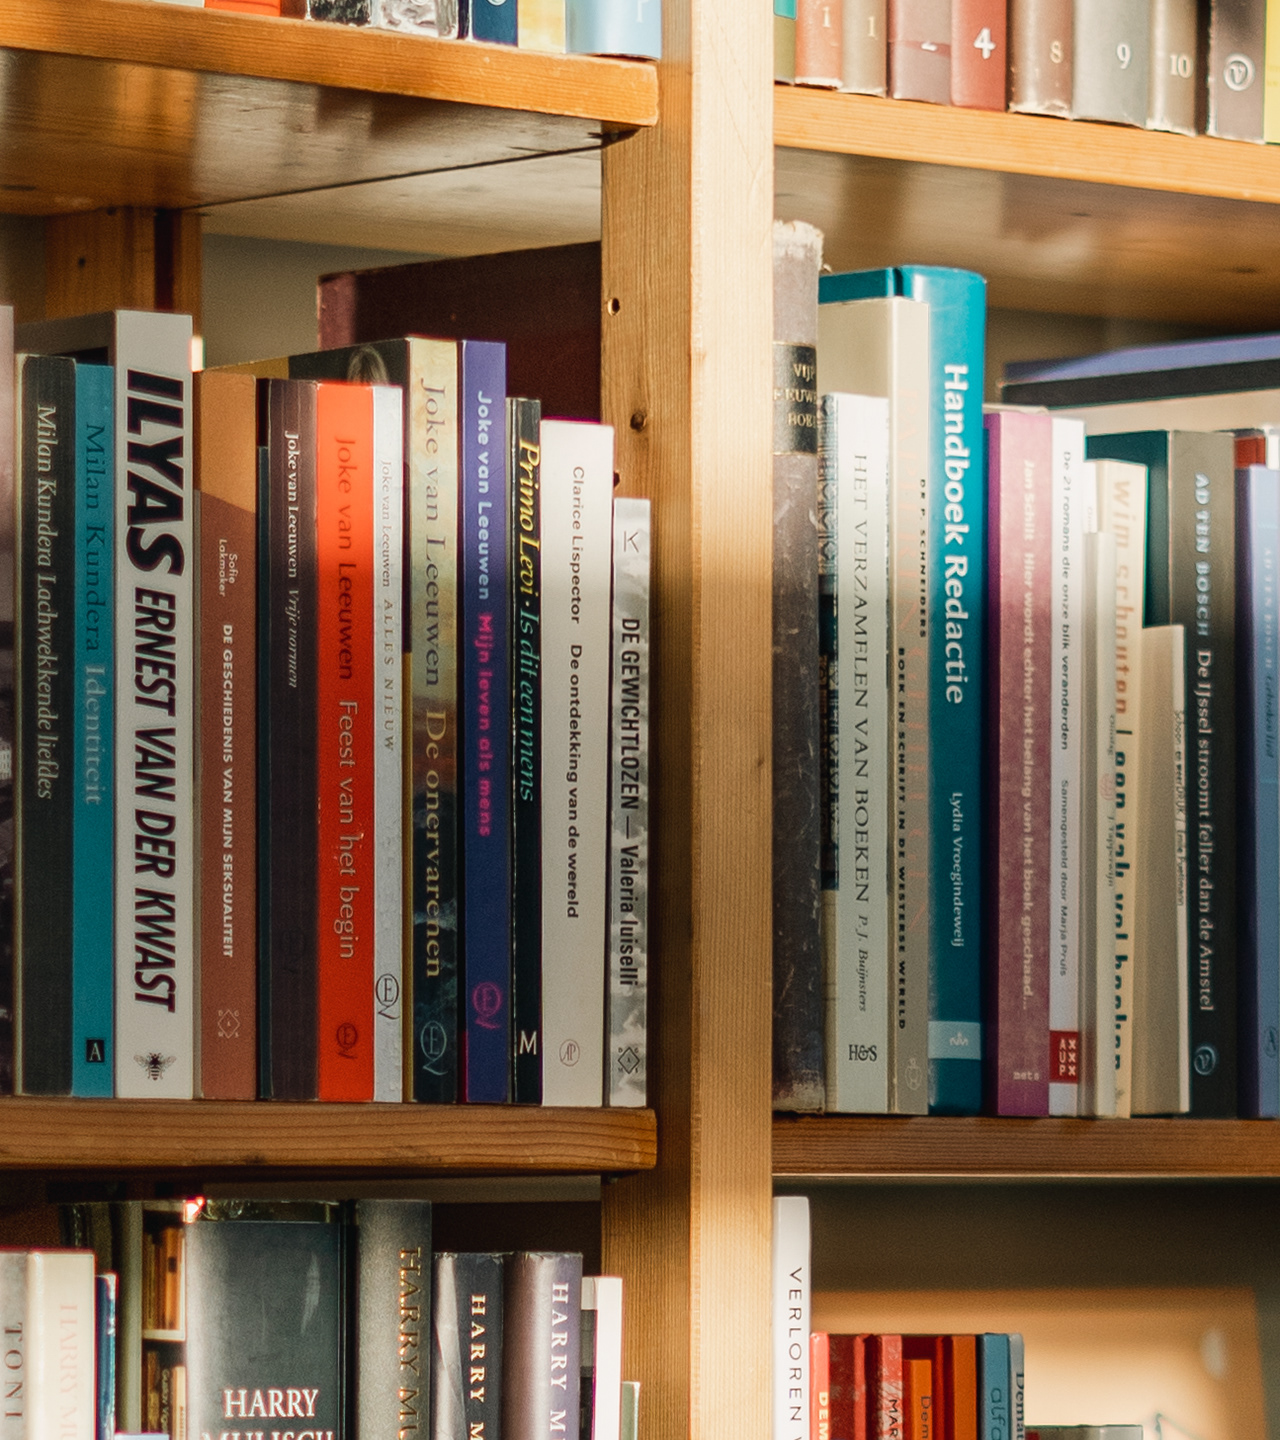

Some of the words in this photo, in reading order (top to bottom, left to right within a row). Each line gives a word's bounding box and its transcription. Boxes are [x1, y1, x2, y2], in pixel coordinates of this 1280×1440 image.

[973, 27, 996, 60] 4
[1117, 41, 1132, 69] 9
[125, 368, 185, 579] ILYAS
[943, 363, 969, 546] Handboek
[572, 466, 585, 530] Clarice
[571, 536, 584, 626] Lispector
[134, 585, 177, 718] ERNEST
[569, 643, 583, 670] De
[622, 617, 639, 647] DE
[944, 555, 970, 705] Redactie
[134, 725, 177, 802] VAN
[565, 673, 582, 784] ontdekking
[620, 653, 639, 812] GEWICHTLOZEN
[567, 786, 579, 822] van
[567, 825, 581, 850] de
[134, 807, 177, 881] DER
[566, 852, 580, 919] wereld
[133, 888, 177, 1013] KWAST
[787, 1266, 804, 1424] VERLOREN
[223, 1388, 320, 1419] HARRY
